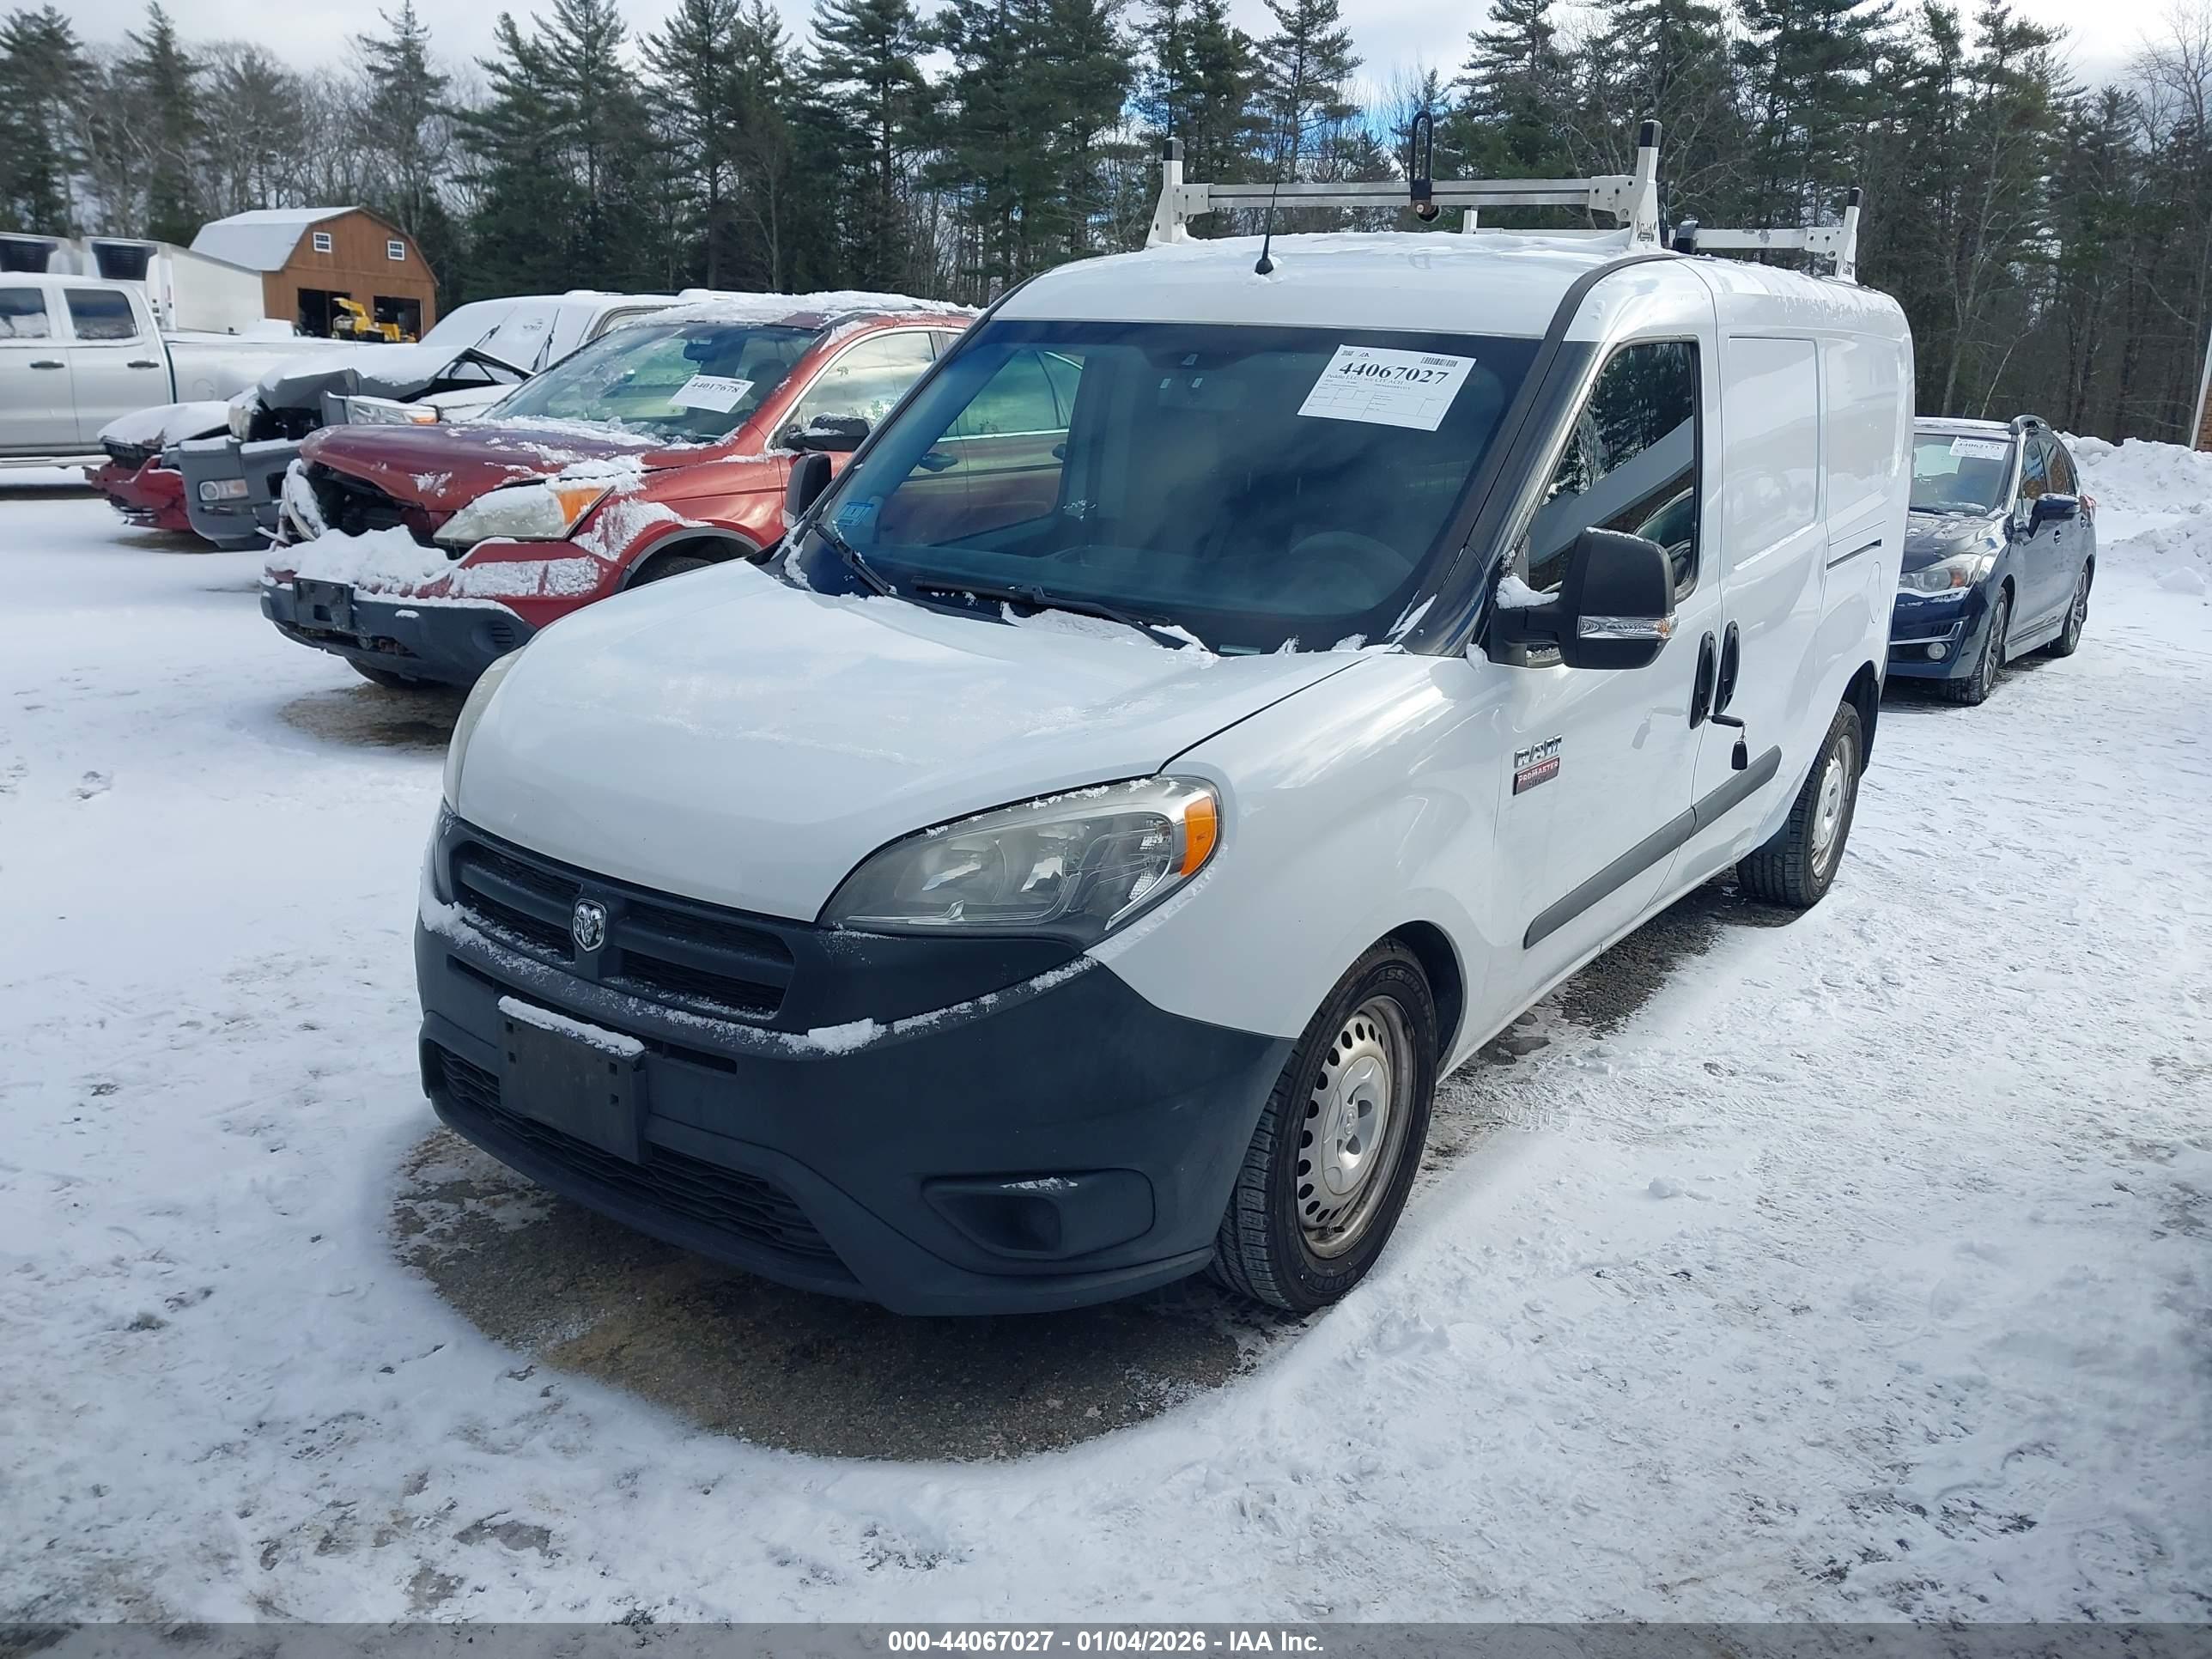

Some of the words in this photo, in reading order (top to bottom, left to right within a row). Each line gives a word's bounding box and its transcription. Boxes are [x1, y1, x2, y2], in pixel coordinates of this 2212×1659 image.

[1339, 362, 1449, 385] 44067027
[1514, 734, 1562, 769] RAM
[1517, 761, 1559, 783] PROMASTER
